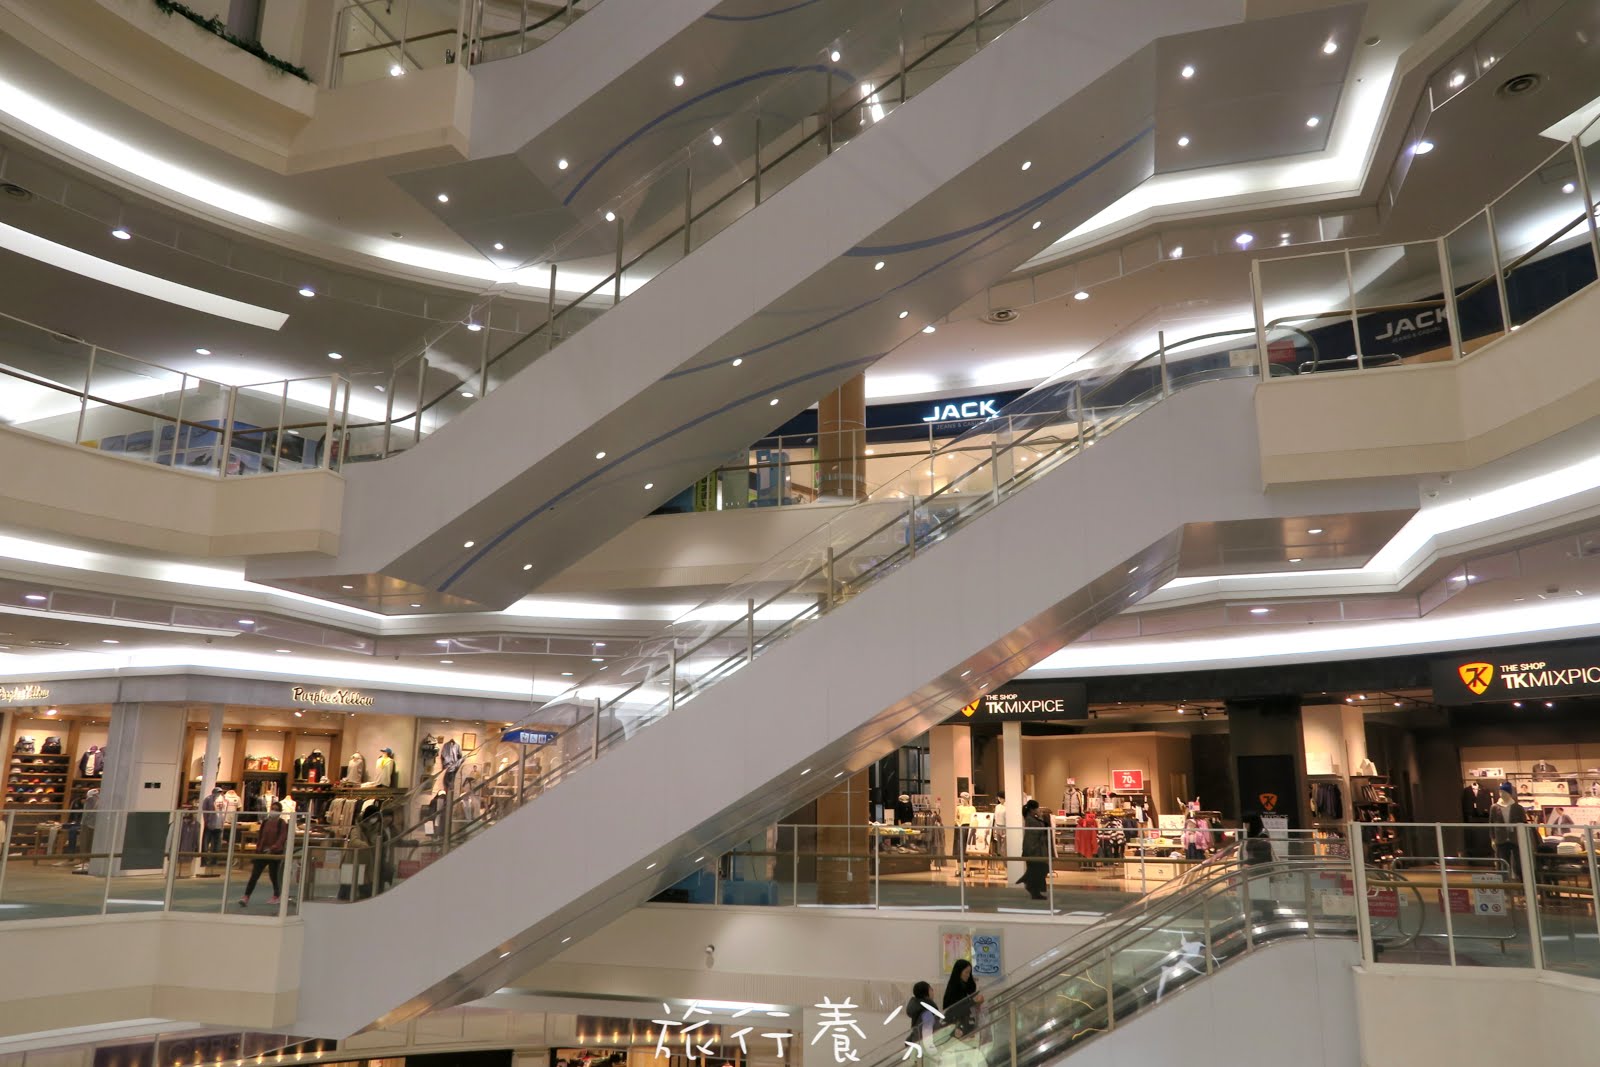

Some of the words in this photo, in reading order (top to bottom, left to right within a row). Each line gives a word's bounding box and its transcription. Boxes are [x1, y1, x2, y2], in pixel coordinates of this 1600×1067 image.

[922, 399, 1000, 422] JACK
[1500, 665, 1519, 673] THE
[1520, 661, 1546, 671] SHOP
[985, 699, 1065, 714] TKMIXPICE
